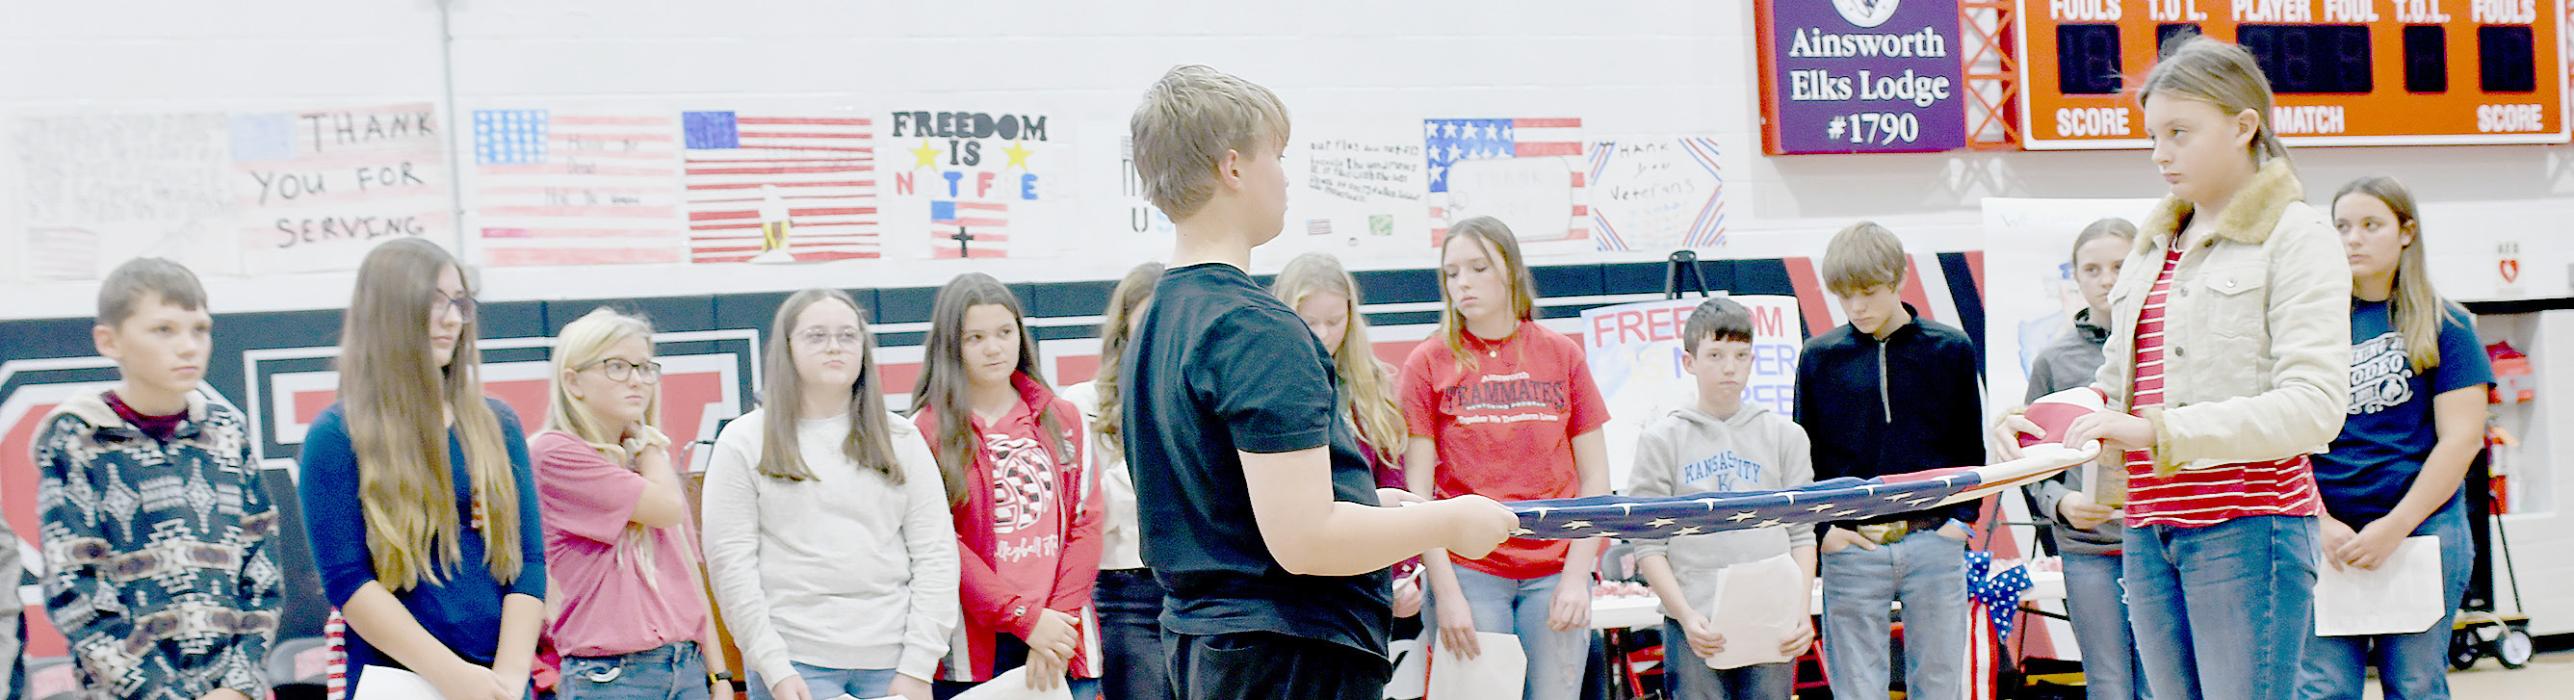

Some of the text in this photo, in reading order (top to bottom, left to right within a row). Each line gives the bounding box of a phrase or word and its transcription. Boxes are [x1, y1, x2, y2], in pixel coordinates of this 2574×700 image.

[2050, 0, 2122, 20] FOULS
[2324, 0, 2380, 22] FOUL
[2471, 0, 2536, 23] FOULS
[1788, 26, 1947, 58] Ainsworth
[1790, 68, 1950, 108] Elks Lodge
[299, 112, 435, 152] THANK
[891, 111, 1048, 141] FREEDOM
[1827, 112, 1919, 146] #1790
[2056, 107, 2130, 136] SCORE
[2274, 105, 2344, 134] MATCH
[2476, 103, 2543, 132] SCORE
[949, 140, 981, 167] IS
[355, 160, 425, 194] FOR
[275, 216, 424, 248] SERVING
[1593, 305, 1784, 348] FREEM
[2351, 354, 2404, 385] ODEO
[1445, 380, 1565, 412] TEAMMATES
[1684, 450, 1761, 484] KANSAS ITY
